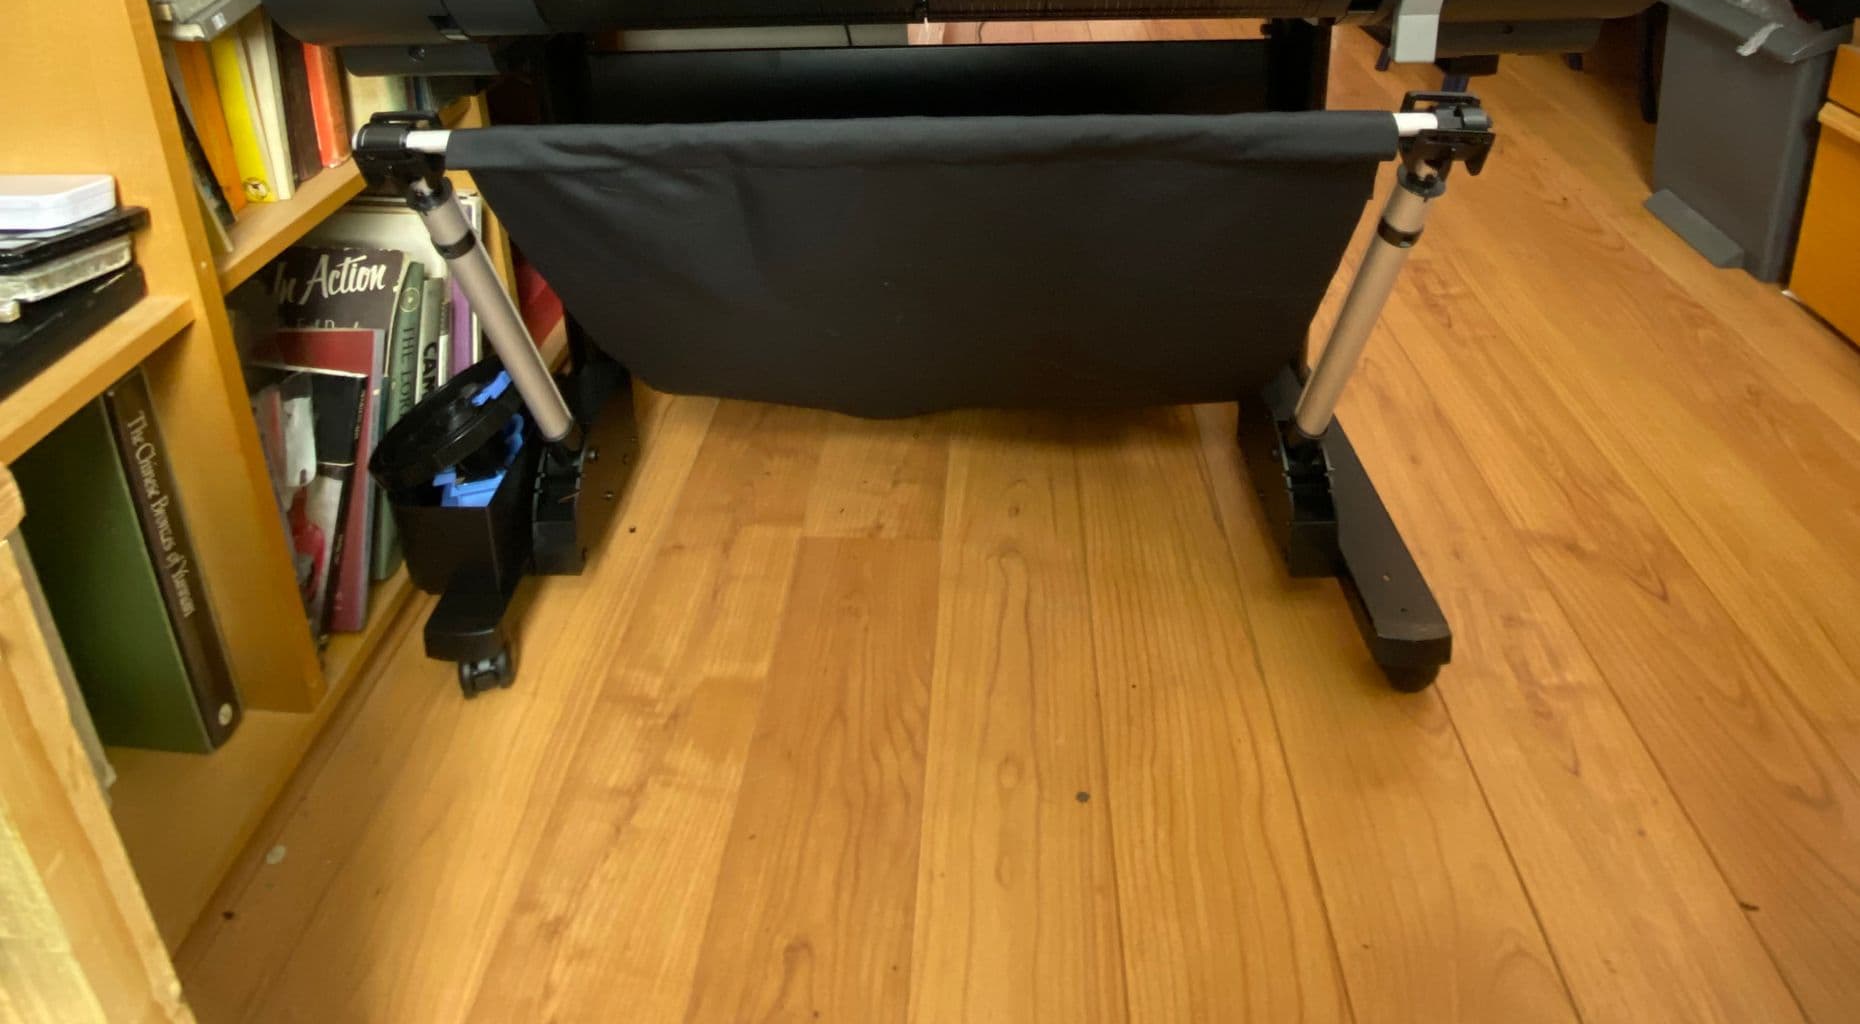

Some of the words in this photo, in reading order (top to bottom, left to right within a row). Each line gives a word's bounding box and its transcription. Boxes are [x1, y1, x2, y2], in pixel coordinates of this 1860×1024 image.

[298, 254, 387, 305] Action
[401, 327, 415, 364] THE
[127, 410, 149, 445] The
[135, 442, 161, 499] Chinese
[151, 495, 177, 553] Bronzes
[165, 550, 186, 570] of
[171, 564, 196, 618] Yunnan
